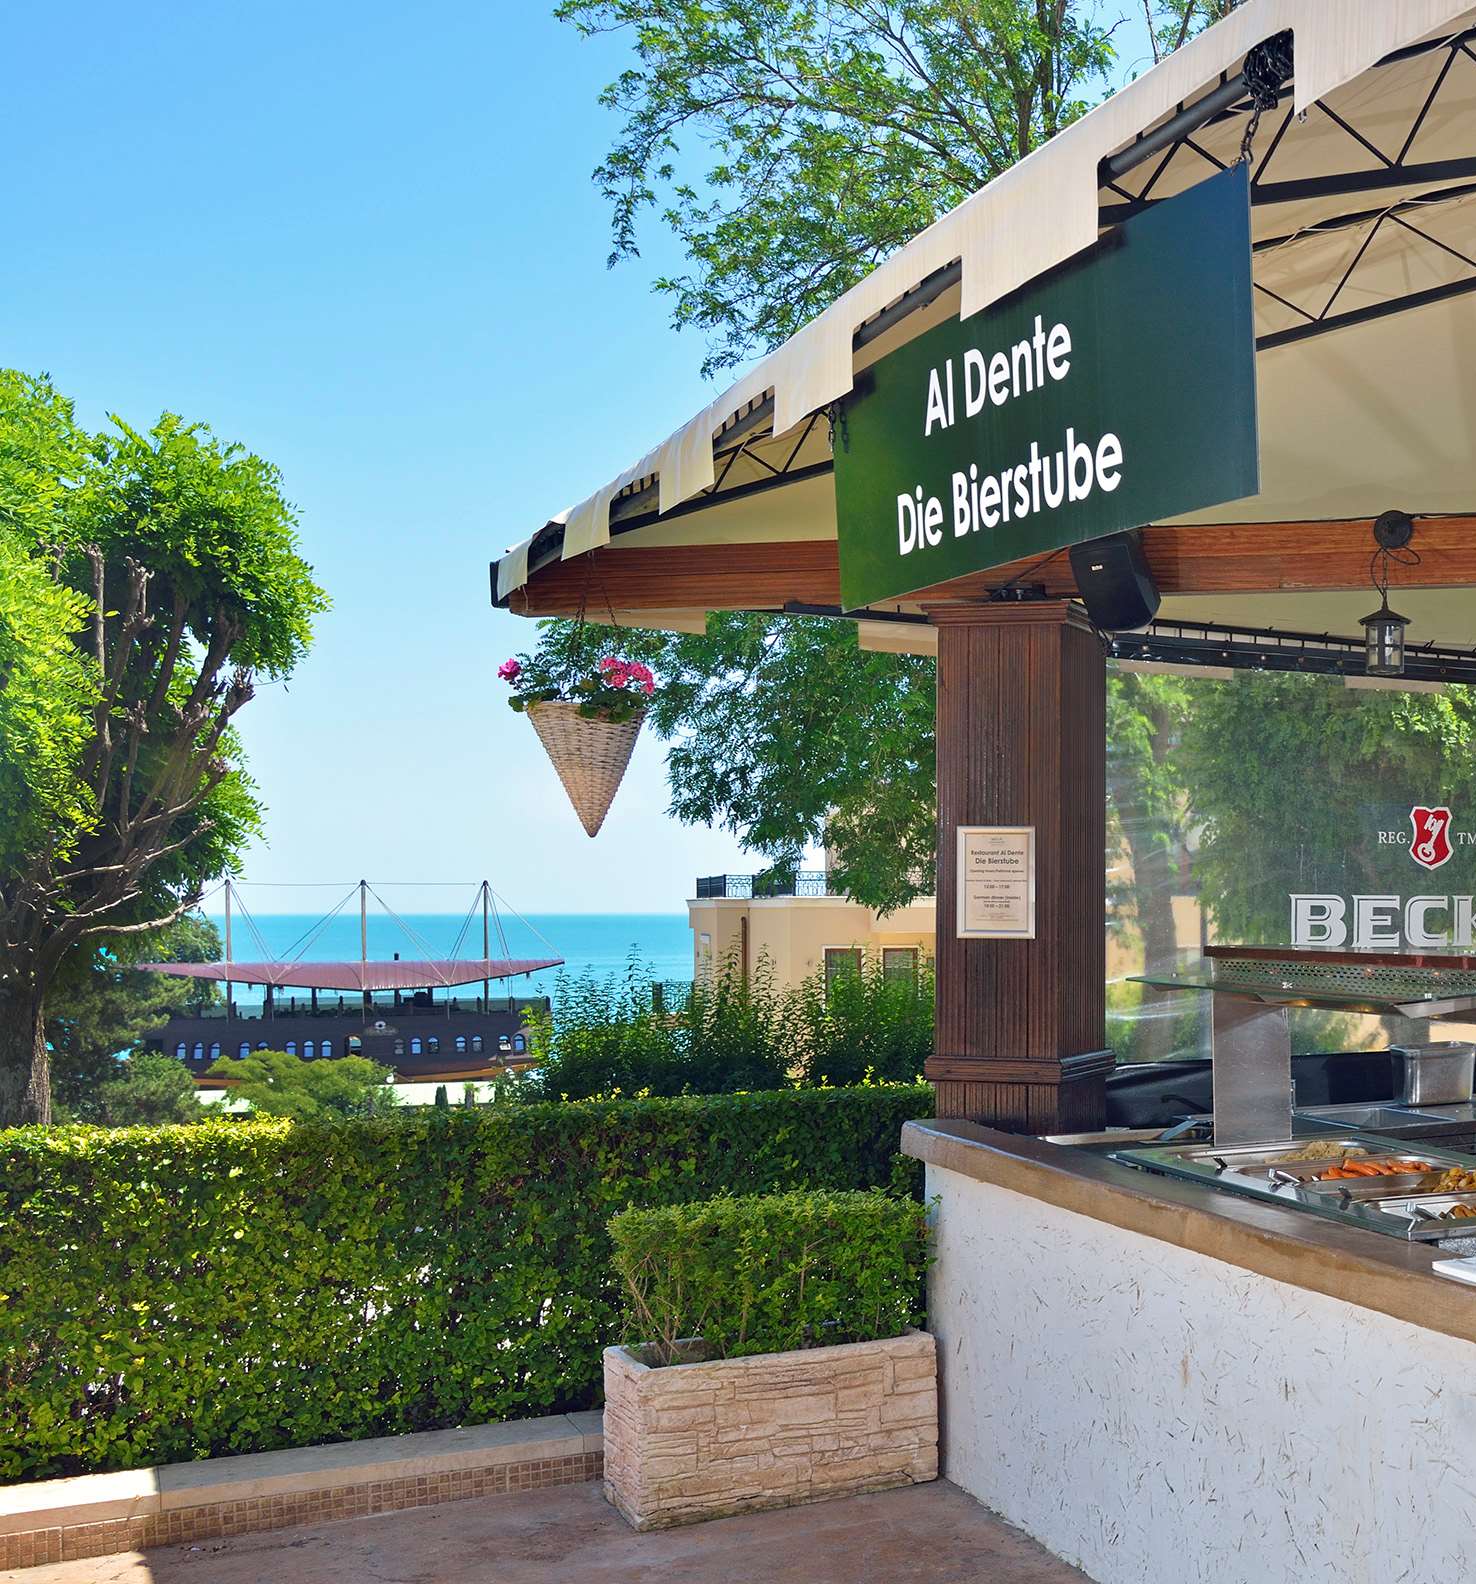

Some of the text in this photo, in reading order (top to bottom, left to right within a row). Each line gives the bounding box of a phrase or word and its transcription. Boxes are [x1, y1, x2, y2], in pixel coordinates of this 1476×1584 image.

[924, 314, 1072, 437] Al Dente
[896, 427, 1124, 556] Die Bierstube
[1378, 831, 1411, 845] REG.
